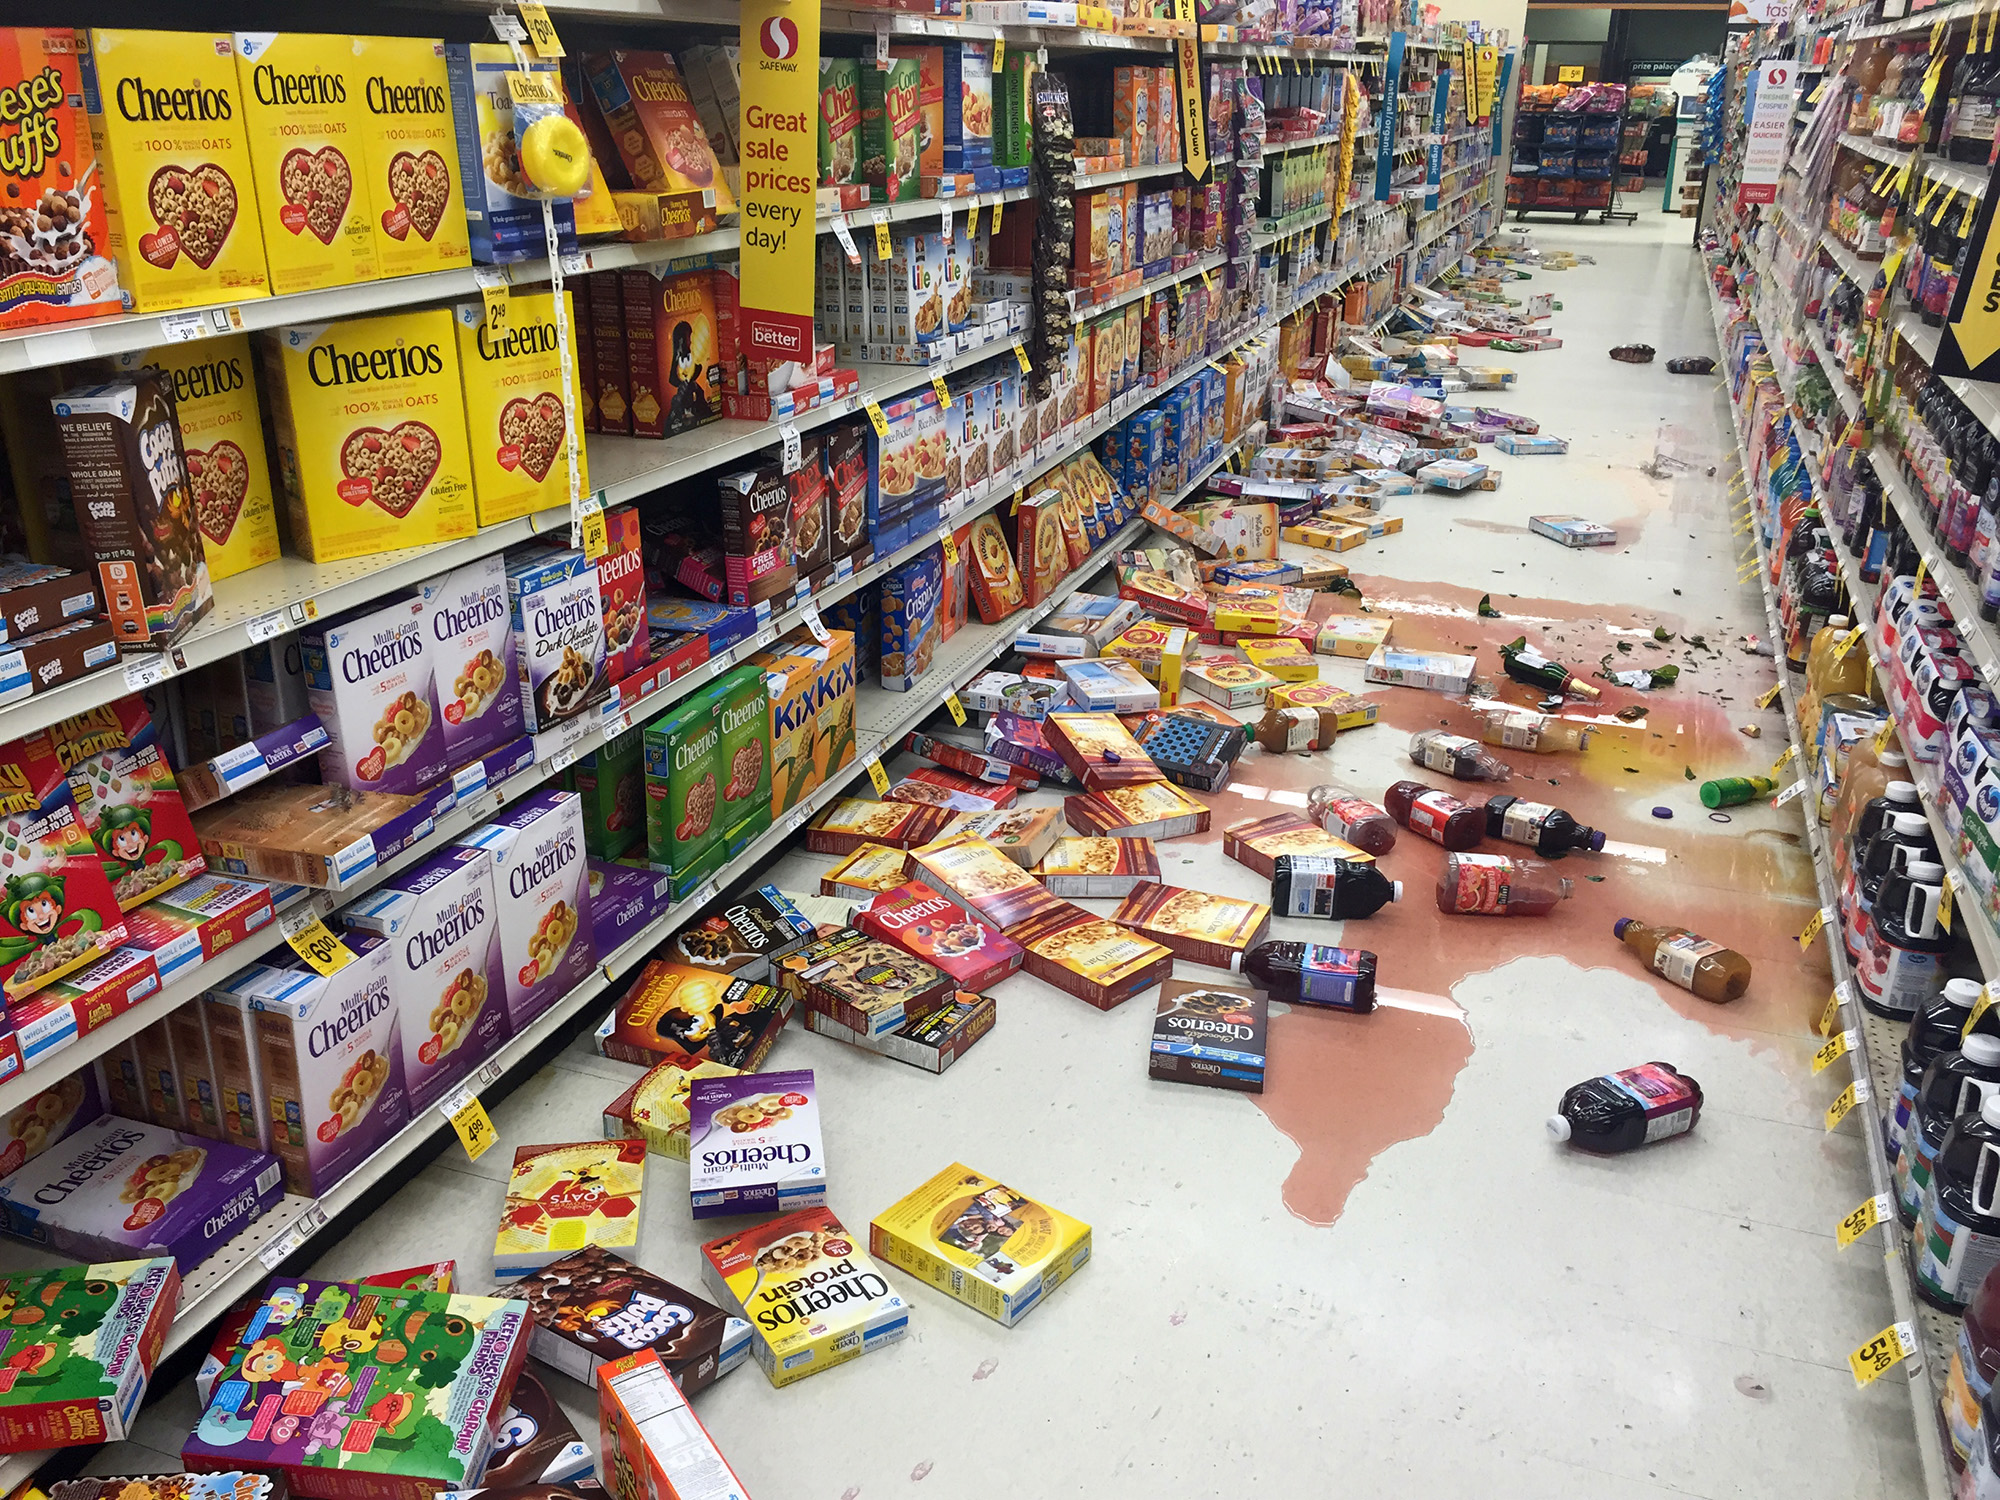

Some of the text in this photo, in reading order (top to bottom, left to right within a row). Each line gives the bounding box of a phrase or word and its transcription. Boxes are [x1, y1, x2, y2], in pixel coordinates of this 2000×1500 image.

[759, 62, 798, 72] SAFEWAY
[1633, 62, 1678, 70] prize palace
[254, 64, 346, 106] Cheerios
[513, 80, 553, 98] Cheerios
[633, 75, 687, 102] Cheerios
[835, 69, 855, 89] Corn
[899, 70, 919, 88] Corn
[117, 77, 231, 121] Cheerios
[366, 77, 445, 114] Cheerios
[821, 86, 859, 124] Chex
[886, 85, 919, 123] Chex
[1184, 40, 1199, 156] LOWER PRICES
[280, 123, 347, 135] 100% OATS
[746, 105, 807, 133] Great
[1382, 79, 1394, 156] natural/organic
[145, 139, 231, 151] 100% OATS
[386, 129, 445, 139] 100% OATS
[746, 139, 789, 162] sale
[746, 169, 811, 194] prices
[662, 207, 691, 226] Cheerios
[746, 202, 801, 226] every
[156, 234, 173, 249] LOWER
[345, 225, 371, 235] Gluten Free
[746, 230, 786, 250] day!
[672, 258, 692, 271] FAMILY
[944, 258, 961, 282] life
[912, 265, 931, 290] life
[664, 289, 701, 312] Cheerios
[754, 329, 797, 347] better
[308, 344, 442, 387] Cheerios
[501, 376, 526, 386] 100%
[344, 394, 438, 414] 100% OATS
[61, 422, 112, 432] WE BELIEVE
[218, 411, 243, 426] OATS
[140, 422, 174, 470] Cocoa
[149, 452, 179, 507] Puffs
[790, 462, 821, 497] Chex
[833, 451, 864, 488] Chex
[431, 482, 467, 496] Gluten Free
[750, 485, 787, 513] Cheerios
[88, 502, 114, 511] Cocoa
[259, 505, 271, 513] Free
[599, 549, 641, 585] heerios
[751, 551, 774, 567] FREE
[460, 583, 500, 607] Multi Grain
[561, 586, 592, 605] Multi Grain
[881, 582, 903, 590] Crispix
[906, 584, 933, 619] Crispix
[980, 598, 990, 614] OATS
[14, 607, 37, 625] Cocoa
[18, 614, 39, 632] Puffs
[434, 595, 504, 640] Cheerios
[535, 596, 595, 638] Cheerios
[373, 619, 419, 647] Multi Grain
[536, 620, 599, 657] Dark Chocolate
[1, 659, 21, 672] GRAIN
[38, 659, 60, 675] Cocoa
[343, 632, 422, 683] Cheerios
[42, 668, 63, 684] Puffs
[380, 683, 386, 692] 5
[817, 657, 854, 708] KiX
[721, 696, 765, 734] Cheerios
[774, 684, 816, 739] KiX
[56, 729, 131, 772] Charms
[147, 751, 159, 764] LIFE
[266, 750, 292, 766] Cheerios
[676, 728, 718, 770] Cheerios
[701, 756, 714, 770] OATS
[22, 805, 70, 836] BRING THEIR
[26, 813, 75, 843] MAGIC TO LIFE
[510, 807, 548, 829] Cheerios
[339, 842, 370, 864] WHOLE GRAIN
[378, 844, 401, 862] Cheerios
[535, 826, 574, 858] Multi Grain
[510, 837, 576, 899] Cheerios
[436, 887, 482, 925] Multi Grain
[616, 901, 644, 927] Cheerios
[879, 896, 951, 929] Cheerios
[292, 933, 306, 944] Club
[406, 899, 485, 970] Cheerios
[724, 905, 769, 948] Cheerios
[157, 937, 196, 962] WHOLE GRAIN
[341, 975, 387, 1012] Multi Grain
[627, 973, 678, 1027] Cheerios
[24, 1012, 70, 1041] WHOLE GRAIN
[309, 987, 389, 1058] Cheerios
[1169, 1017, 1254, 1040] Cheerios
[1191, 1061, 1220, 1075] Cheerios
[454, 1111, 465, 1122] Club
[469, 1119, 483, 1142] 499
[63, 1128, 125, 1171] Multi Grain
[703, 1143, 811, 1166] Cheerios
[35, 1131, 145, 1205] Cheerios
[703, 1162, 768, 1174] Multi Grain
[551, 1193, 598, 1204] OATS
[743, 1186, 776, 1196] Cheerios
[204, 1193, 254, 1239] Cheerios
[759, 1260, 858, 1302] protein
[757, 1275, 888, 1331] Cheerios
[503, 1312, 522, 1345] MEET
[623, 1302, 697, 1350] Cocoa
[468, 1330, 498, 1376] FRIENDS
[1860, 1337, 1891, 1371] 549
[477, 1348, 505, 1397] LUCKY'S
